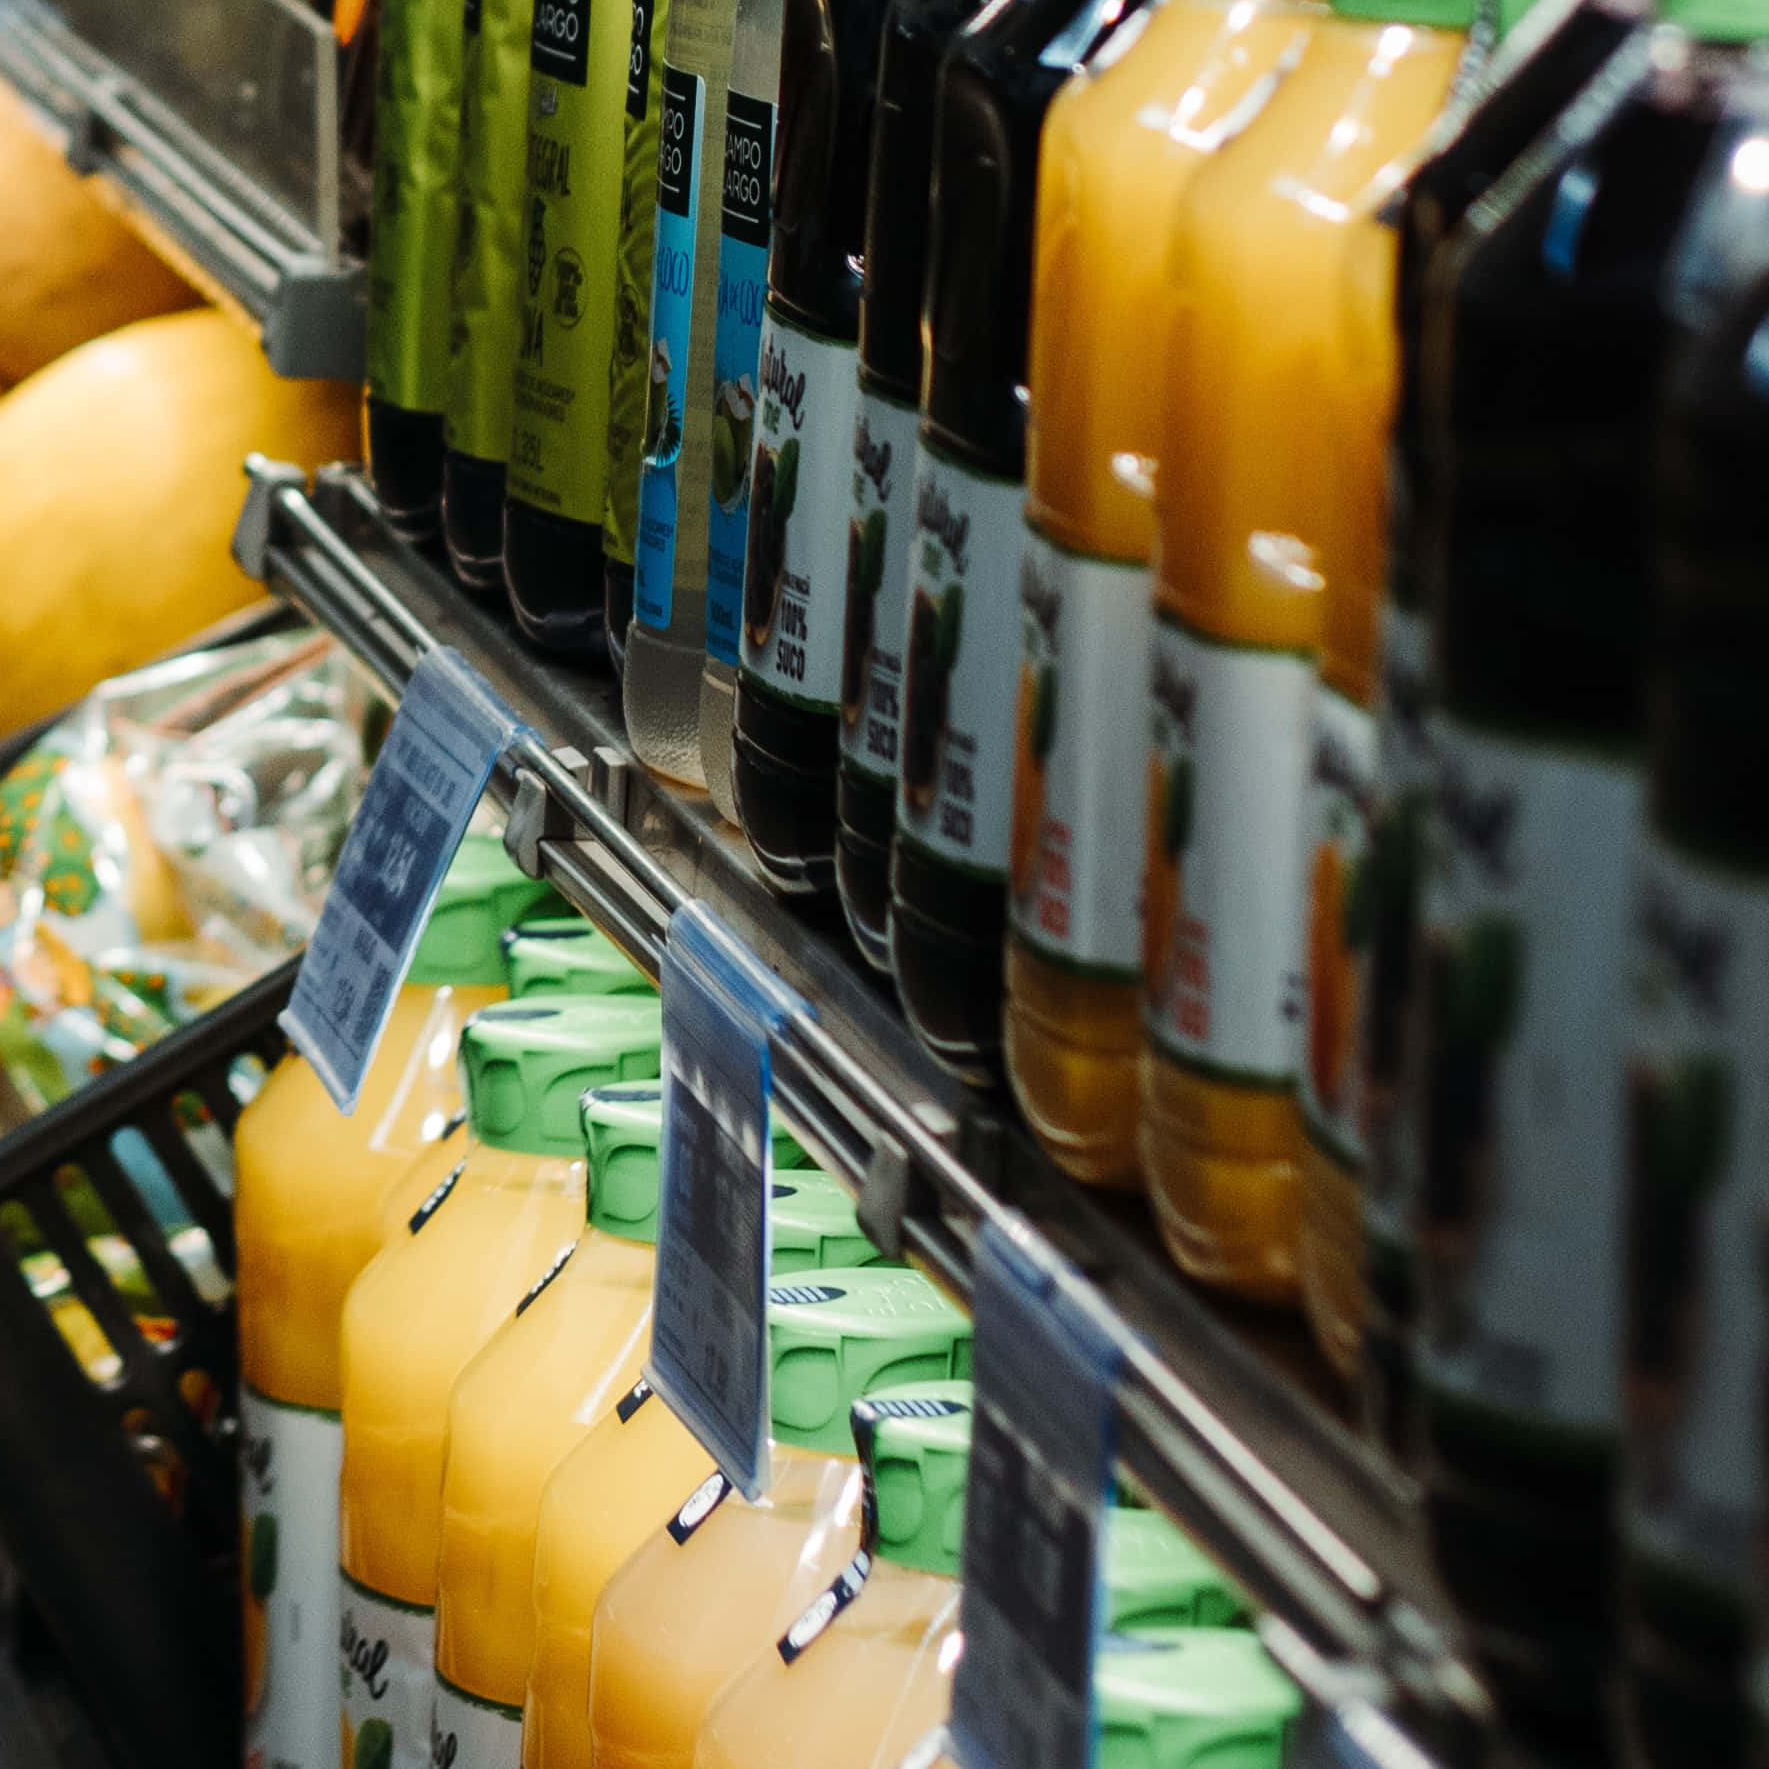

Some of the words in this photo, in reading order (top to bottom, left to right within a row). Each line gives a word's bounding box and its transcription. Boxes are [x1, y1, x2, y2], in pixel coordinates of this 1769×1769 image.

[535, 4, 579, 43] ARGO
[726, 131, 762, 170] AMPO
[723, 169, 761, 206] ARGO
[775, 637, 806, 683] SUCO
